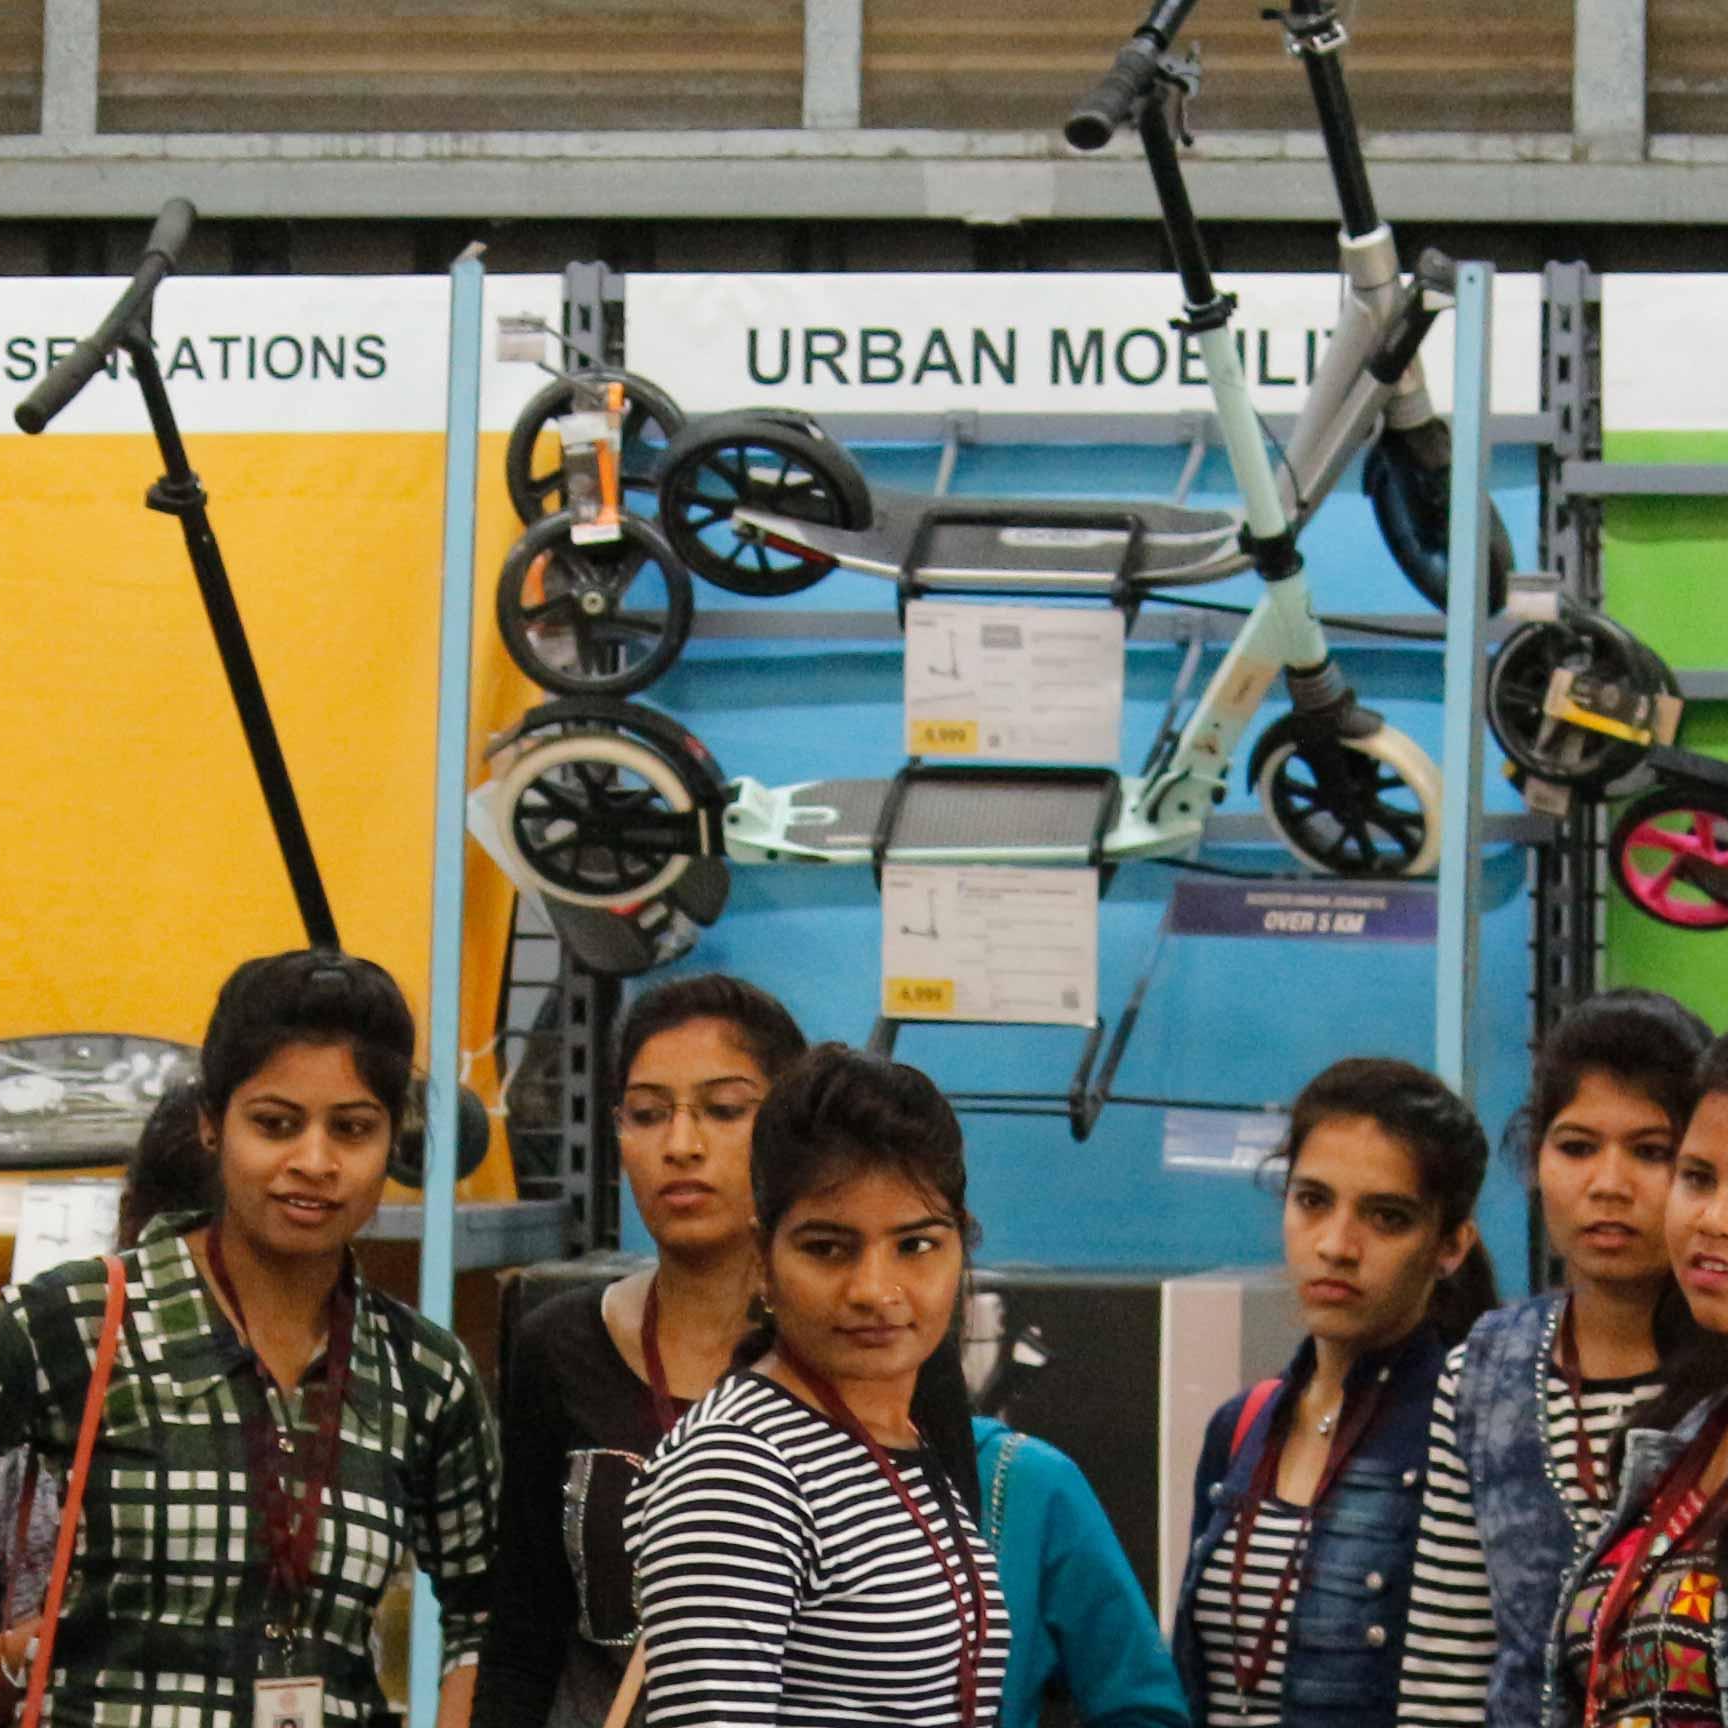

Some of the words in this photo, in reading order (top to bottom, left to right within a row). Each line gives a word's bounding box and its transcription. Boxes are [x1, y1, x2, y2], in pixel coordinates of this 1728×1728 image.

[3, 334, 388, 382] SEATIONS
[746, 327, 1017, 386] URBAN
[1049, 327, 1334, 386] MOBILI
